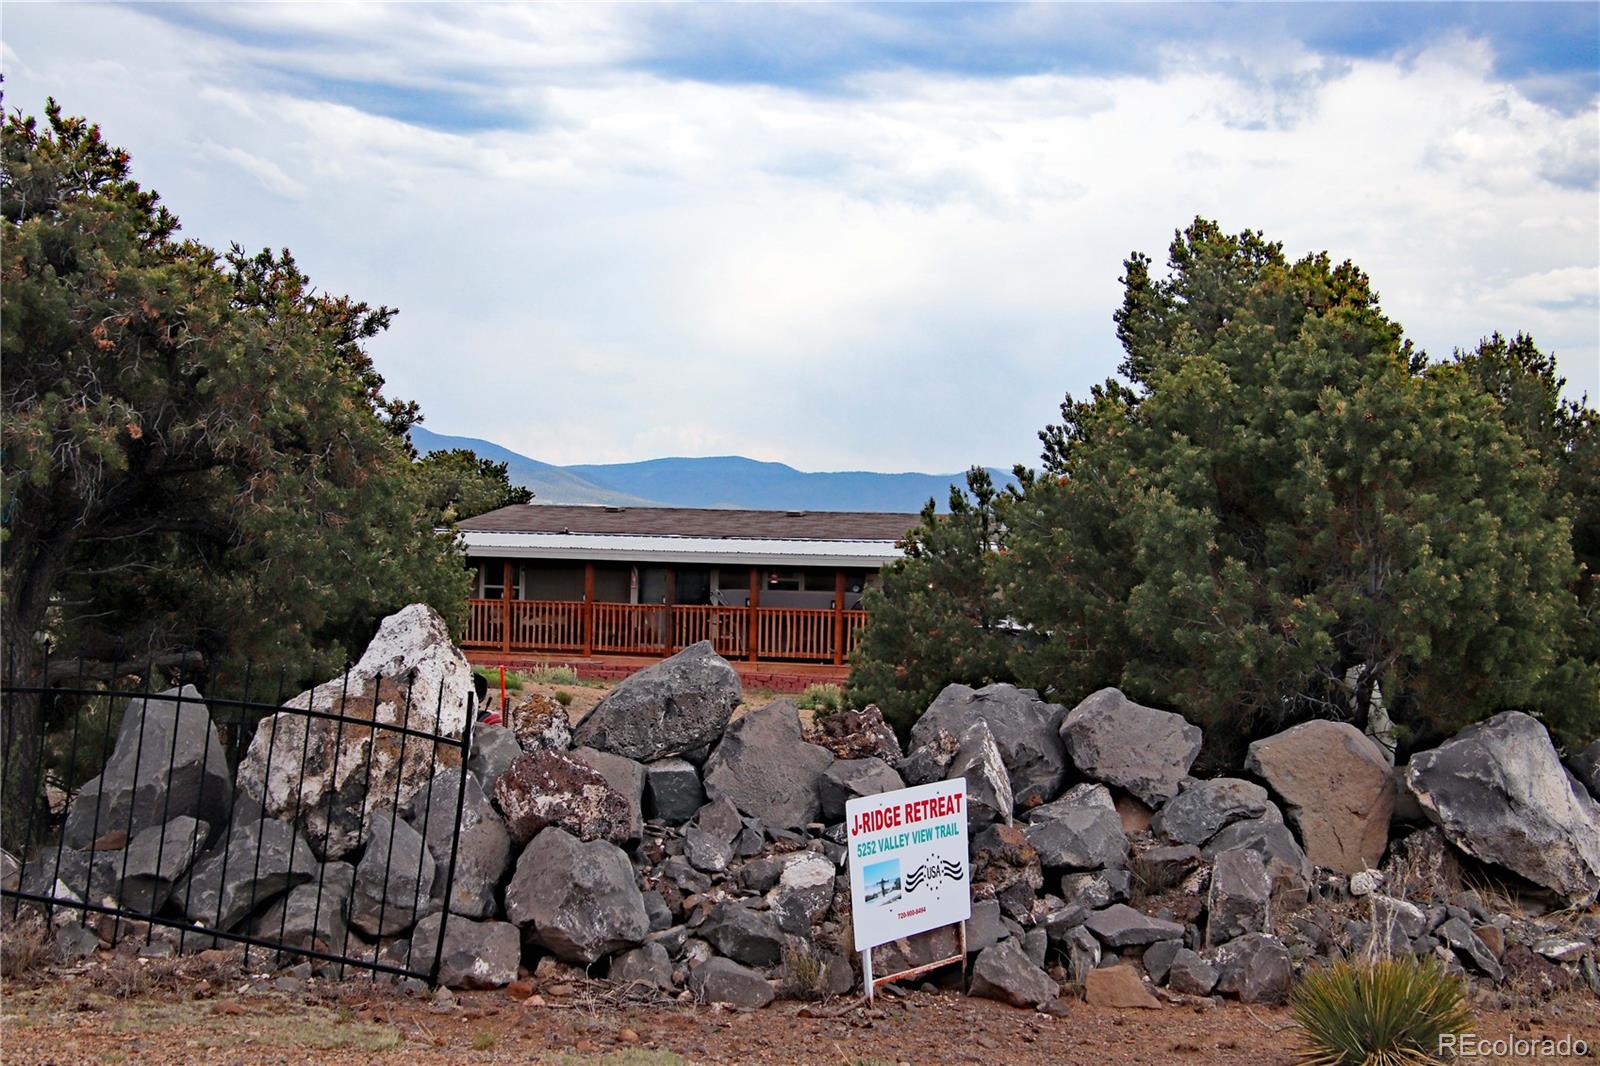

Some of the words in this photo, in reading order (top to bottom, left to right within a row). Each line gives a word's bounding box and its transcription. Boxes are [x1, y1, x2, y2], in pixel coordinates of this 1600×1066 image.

[852, 806, 901, 836] J-RIDGE
[905, 793, 962, 824] RETREAT
[857, 841, 877, 858] 5252
[878, 832, 910, 852] VALLEY
[912, 827, 933, 844] VIEW
[935, 822, 959, 839] TRAIL
[926, 865, 941, 880] USA
